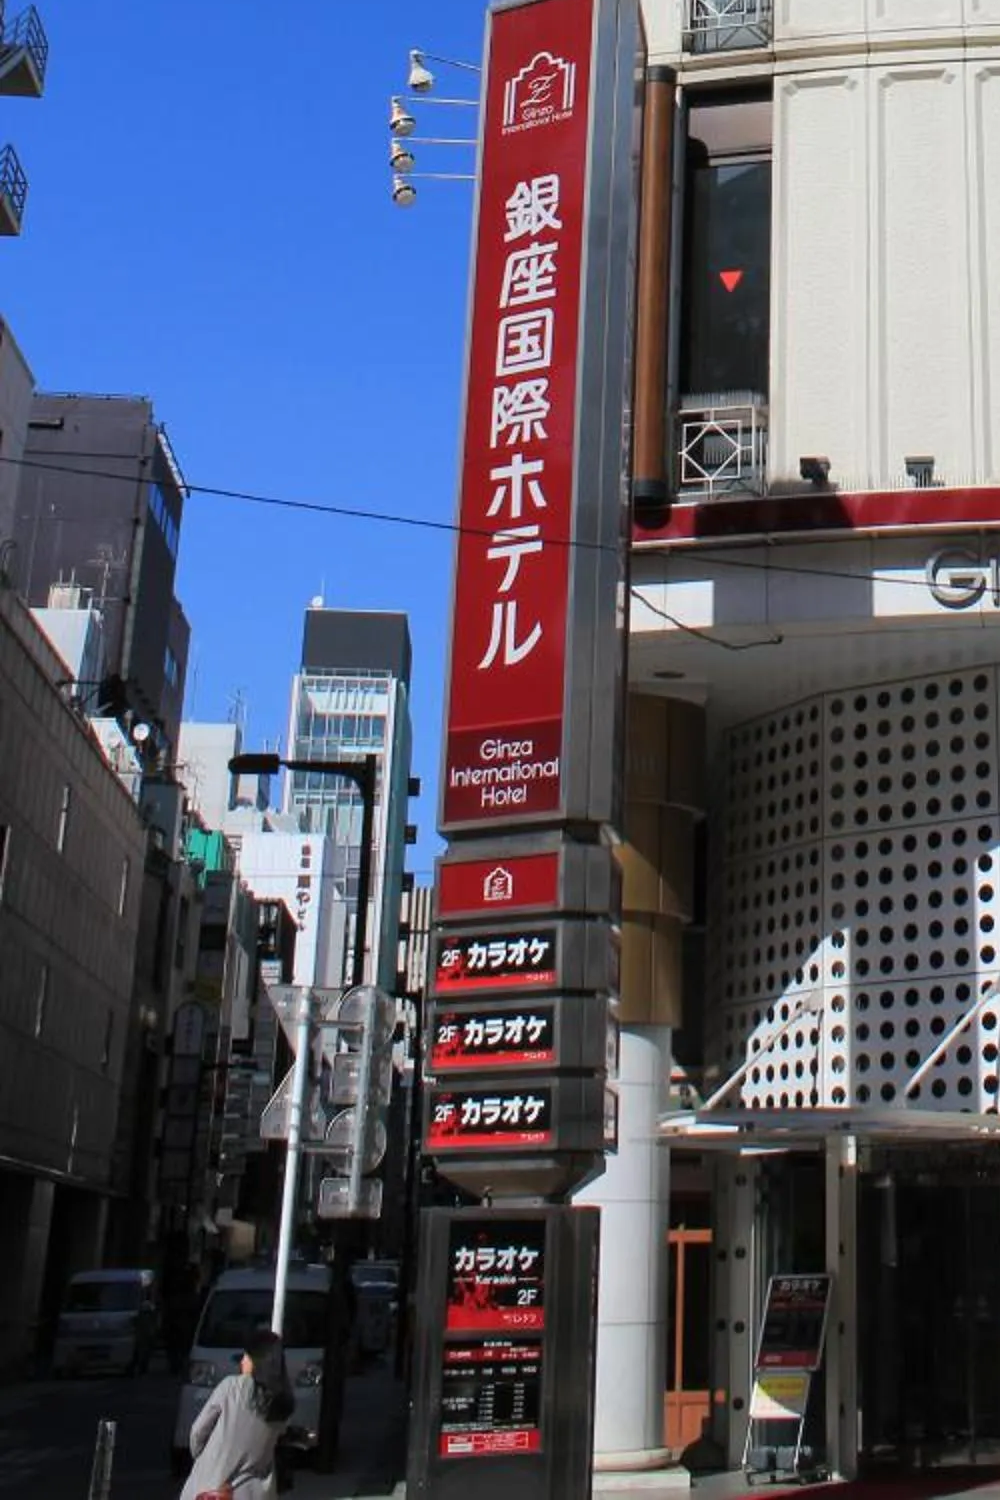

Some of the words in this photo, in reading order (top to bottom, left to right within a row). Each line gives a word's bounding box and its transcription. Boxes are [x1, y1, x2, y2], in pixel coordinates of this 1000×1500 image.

[478, 173, 562, 669] 銀座国際ホテル
[480, 739, 534, 761] Ginza
[450, 757, 559, 788] International
[480, 785, 527, 808] Hotel
[441, 949, 461, 967] 2F
[467, 937, 549, 969] カラオケ
[438, 1025, 458, 1044] 2F
[464, 1015, 547, 1045] カラオケ
[435, 1104, 455, 1122] 2F
[460, 1095, 544, 1125] カラオケ
[455, 1246, 539, 1271] カラオケ
[517, 1289, 537, 1305] 2F
